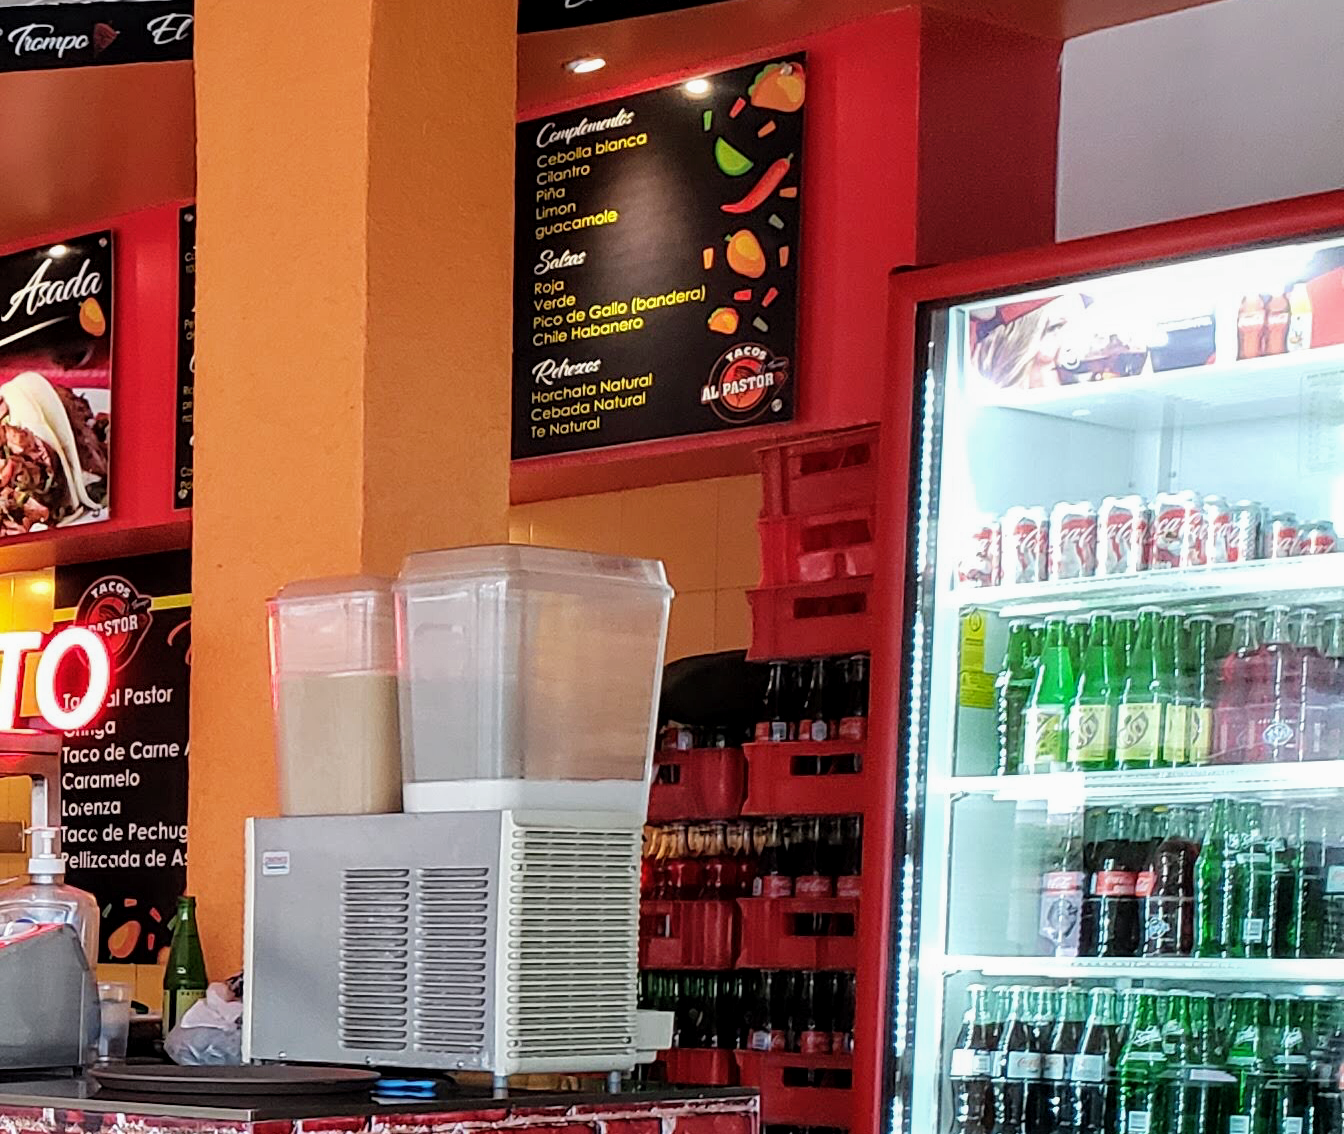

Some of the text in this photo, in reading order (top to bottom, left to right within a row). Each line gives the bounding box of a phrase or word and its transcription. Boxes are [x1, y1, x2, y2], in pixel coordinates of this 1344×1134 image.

[8, 23, 90, 57] Trompo
[147, 13, 194, 45] El
[536, 108, 635, 148] Complementos
[537, 133, 648, 168] Cebolla blanca
[536, 165, 591, 185] Cilantro
[536, 188, 566, 203] Piña
[536, 203, 577, 220] Limon
[535, 209, 619, 240] guacamole
[533, 249, 587, 275] Salsas
[0, 258, 104, 322] Asada
[534, 279, 565, 295] Roja
[533, 294, 577, 312] Verde
[533, 284, 706, 330] Pico de Gallo (bandera)
[532, 317, 644, 346] Chile Habanero
[725, 346, 768, 362] TACOS
[531, 372, 653, 404] Horchata Natural
[701, 372, 774, 404] AL PASTOR
[531, 391, 646, 421] Cebada Natural
[531, 416, 601, 439] Te Natural
[91, 581, 132, 598] TACOS
[124, 685, 173, 706] Pastor
[62, 746, 100, 764] Taco
[104, 743, 126, 761] de
[129, 741, 180, 760] Carne
[62, 769, 141, 790] Caramelo
[62, 799, 122, 816] Lorenza
[61, 825, 99, 843] Taco
[102, 823, 124, 841] de
[61, 849, 141, 869] Pellizcada
[145, 849, 167, 867] de
